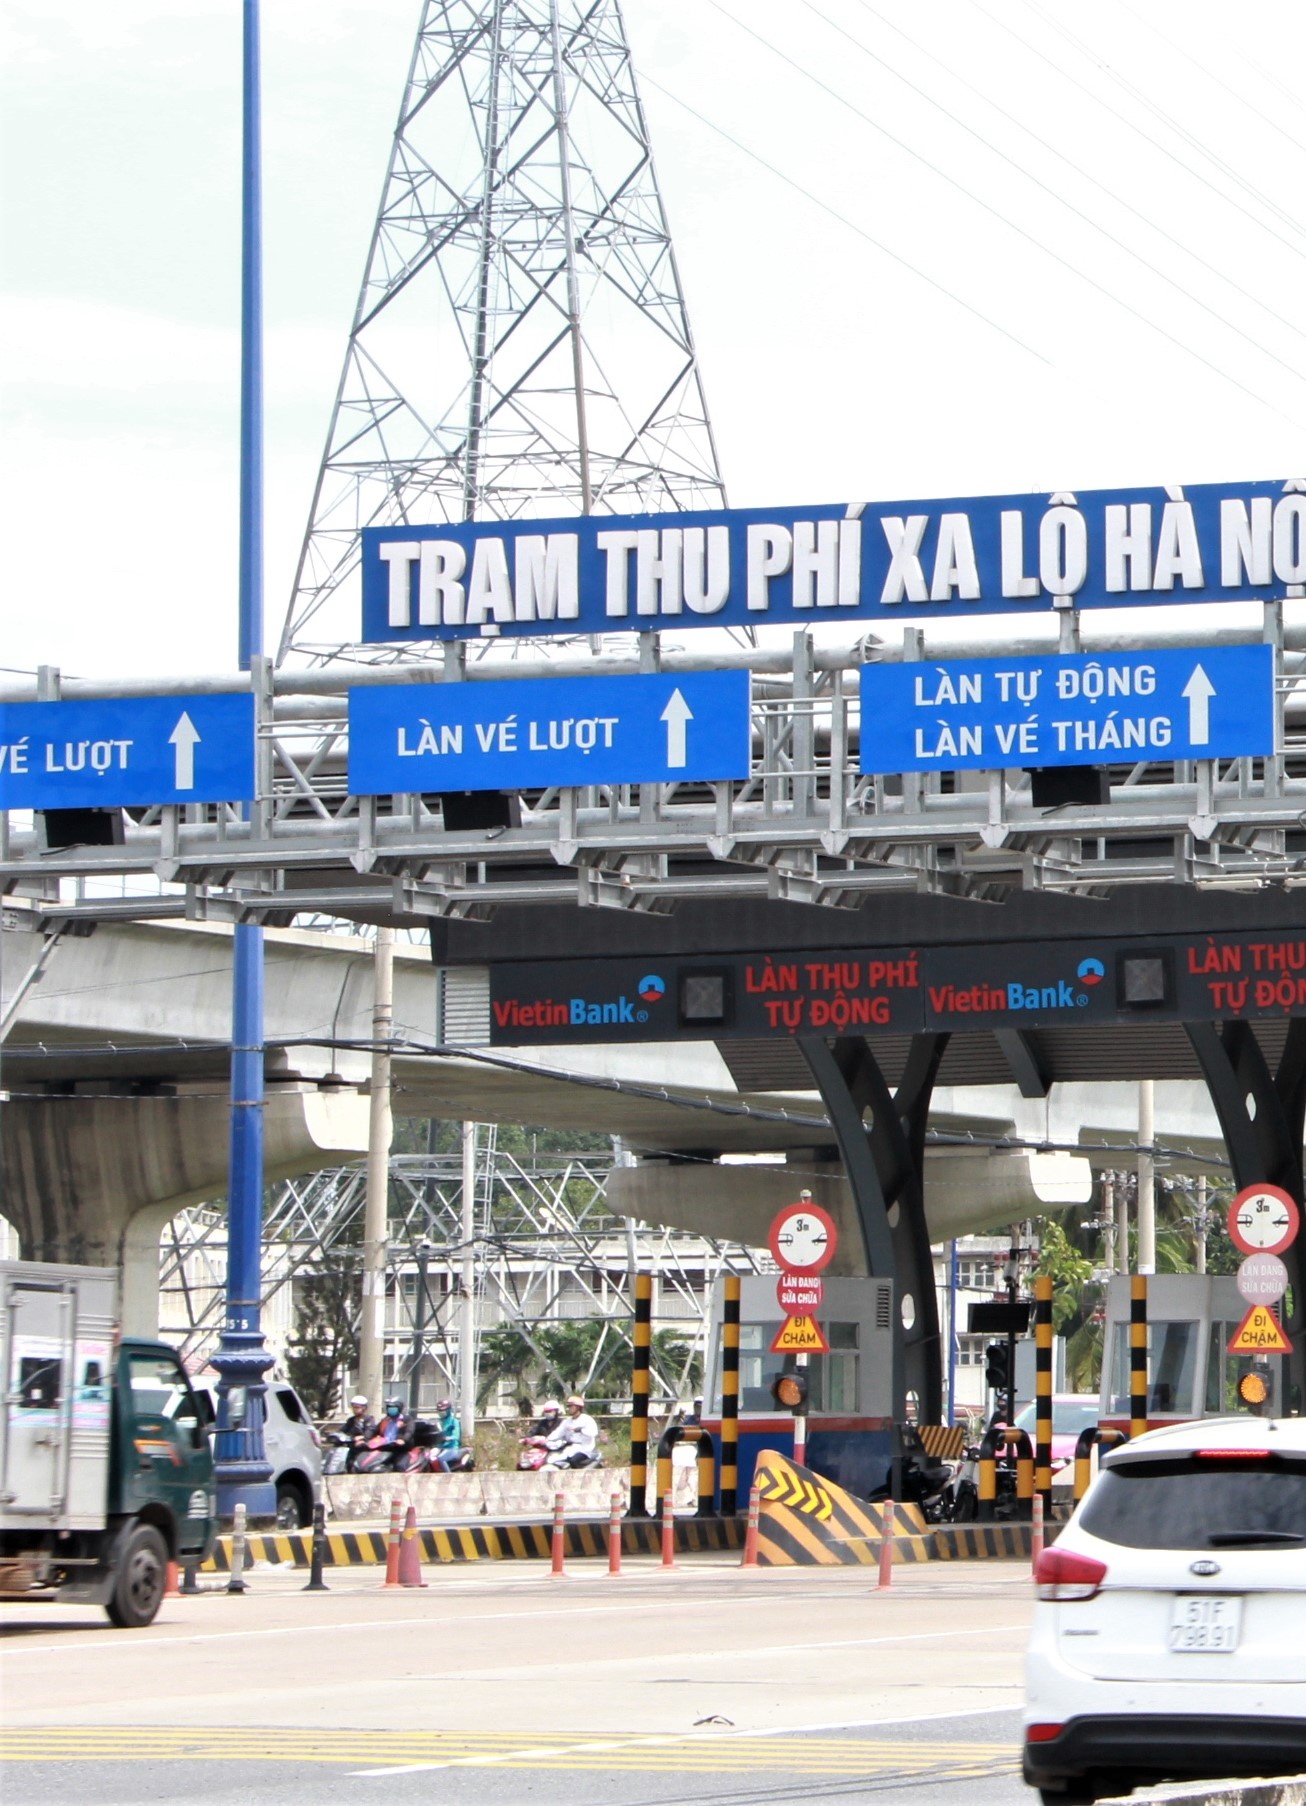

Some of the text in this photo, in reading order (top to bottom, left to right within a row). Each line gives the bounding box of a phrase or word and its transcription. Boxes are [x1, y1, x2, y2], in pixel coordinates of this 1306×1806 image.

[379, 533, 578, 636] TRẠM
[597, 525, 730, 617] THU
[747, 501, 865, 610] PHÍ
[880, 513, 980, 604] XA
[1001, 492, 1087, 608] LỘ
[1105, 486, 1205, 593] HÀ
[915, 662, 1156, 707] LÀN TỰ ĐỘNG
[398, 714, 619, 757] LÀN VÉ LƯỢT
[915, 710, 1172, 758] LÀN VÉ THÁNG
[46, 739, 134, 776] LƯỢT
[746, 951, 919, 994] LÀN THU PHÍ
[1188, 937, 1241, 974] LÀN
[1248, 943, 1305, 972] THU
[493, 996, 635, 1027] VietinBank
[764, 990, 892, 1034] TỰ ĐỘNG
[928, 980, 1075, 1014] VietinBank
[1208, 978, 1249, 1014] TỰ
[1254, 1314, 1266, 1326] ĐI
[1187, 1600, 1226, 1623] 51F
